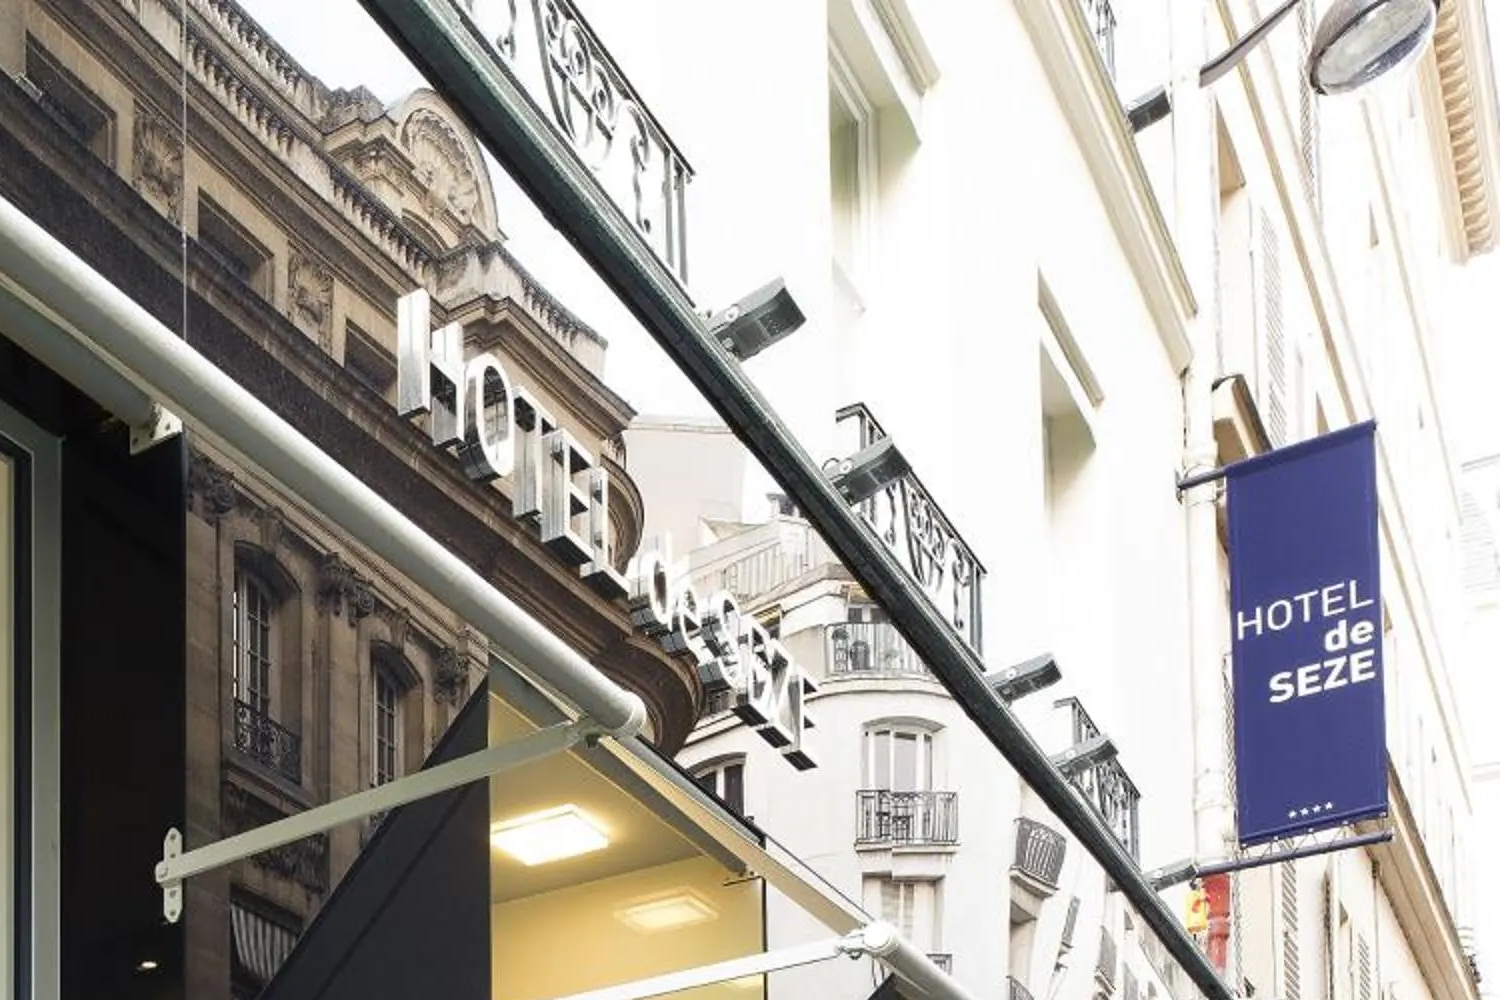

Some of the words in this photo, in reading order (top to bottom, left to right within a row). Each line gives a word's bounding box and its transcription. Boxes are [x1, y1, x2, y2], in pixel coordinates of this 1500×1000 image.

[396, 288, 632, 600] HOTEL
[1237, 580, 1375, 641] HOTEL
[1324, 619, 1375, 653] de
[1269, 649, 1376, 703] SEZE
